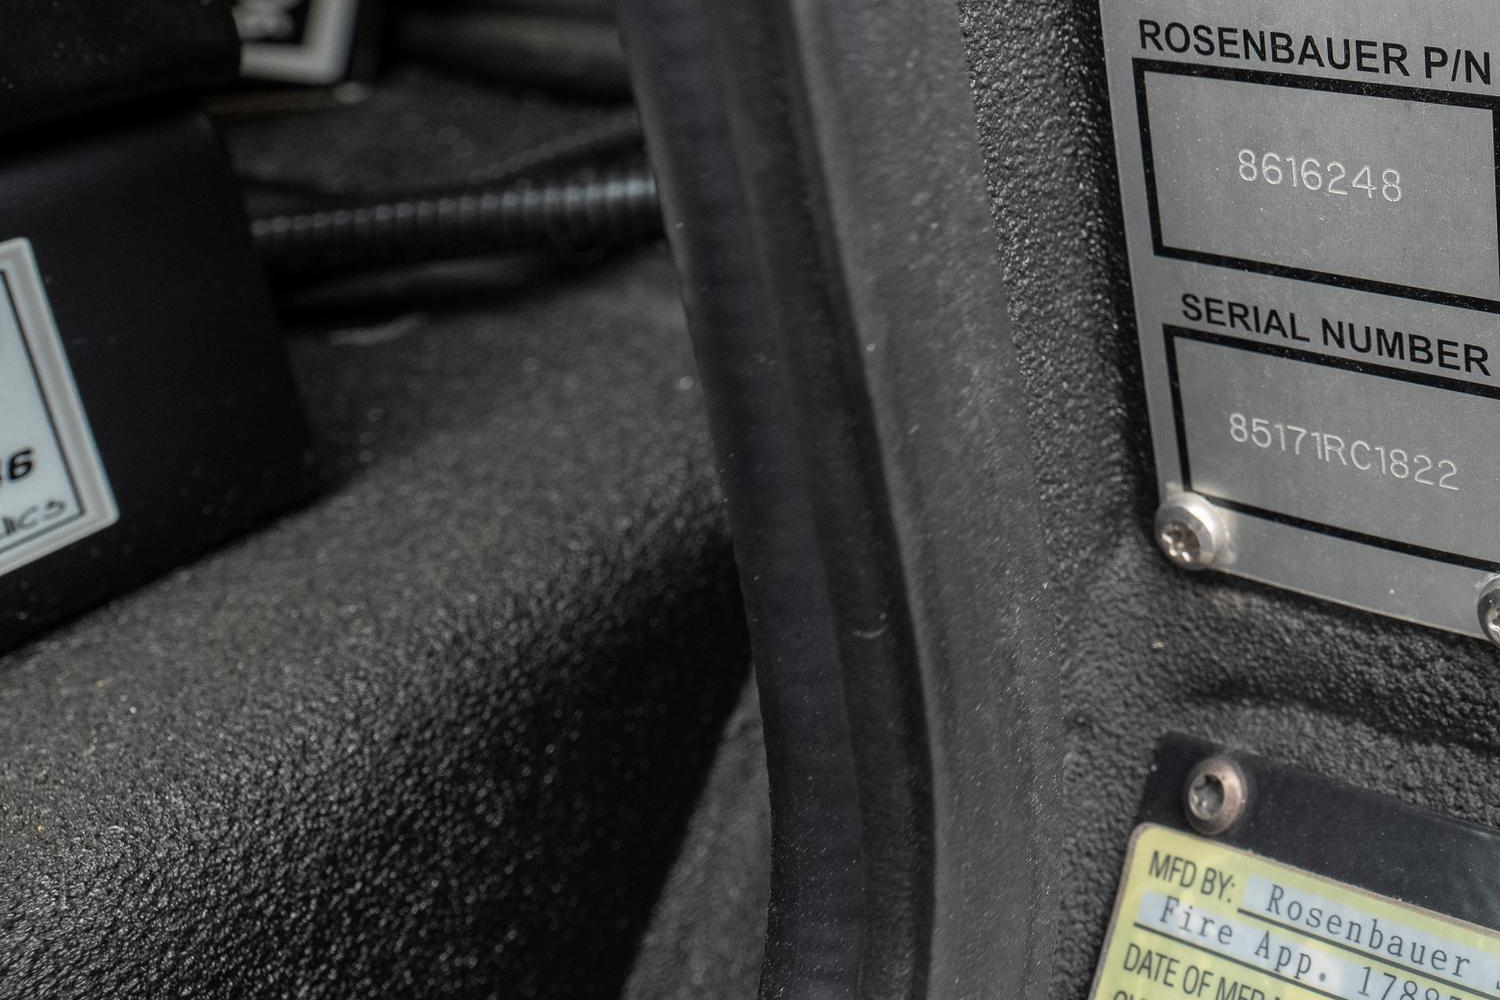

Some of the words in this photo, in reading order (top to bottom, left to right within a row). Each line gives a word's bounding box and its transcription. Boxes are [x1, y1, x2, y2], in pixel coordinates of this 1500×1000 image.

[1138, 19, 1410, 77] ROSENBAUER
[1424, 46, 1492, 86] P/N
[1238, 148, 1402, 202] 8616248
[1181, 293, 1310, 343] SERIAL
[1322, 318, 1492, 377] NUMBER
[1229, 412, 1460, 491] 85171RC1822
[1148, 850, 1198, 889] MFD
[1200, 866, 1236, 904] BY:
[1266, 883, 1471, 978] Rosenbauer
[1159, 895, 1234, 946] Fire
[1253, 930, 1328, 982] App.
[1122, 943, 1180, 988] DATE
[1182, 965, 1214, 998] OF
